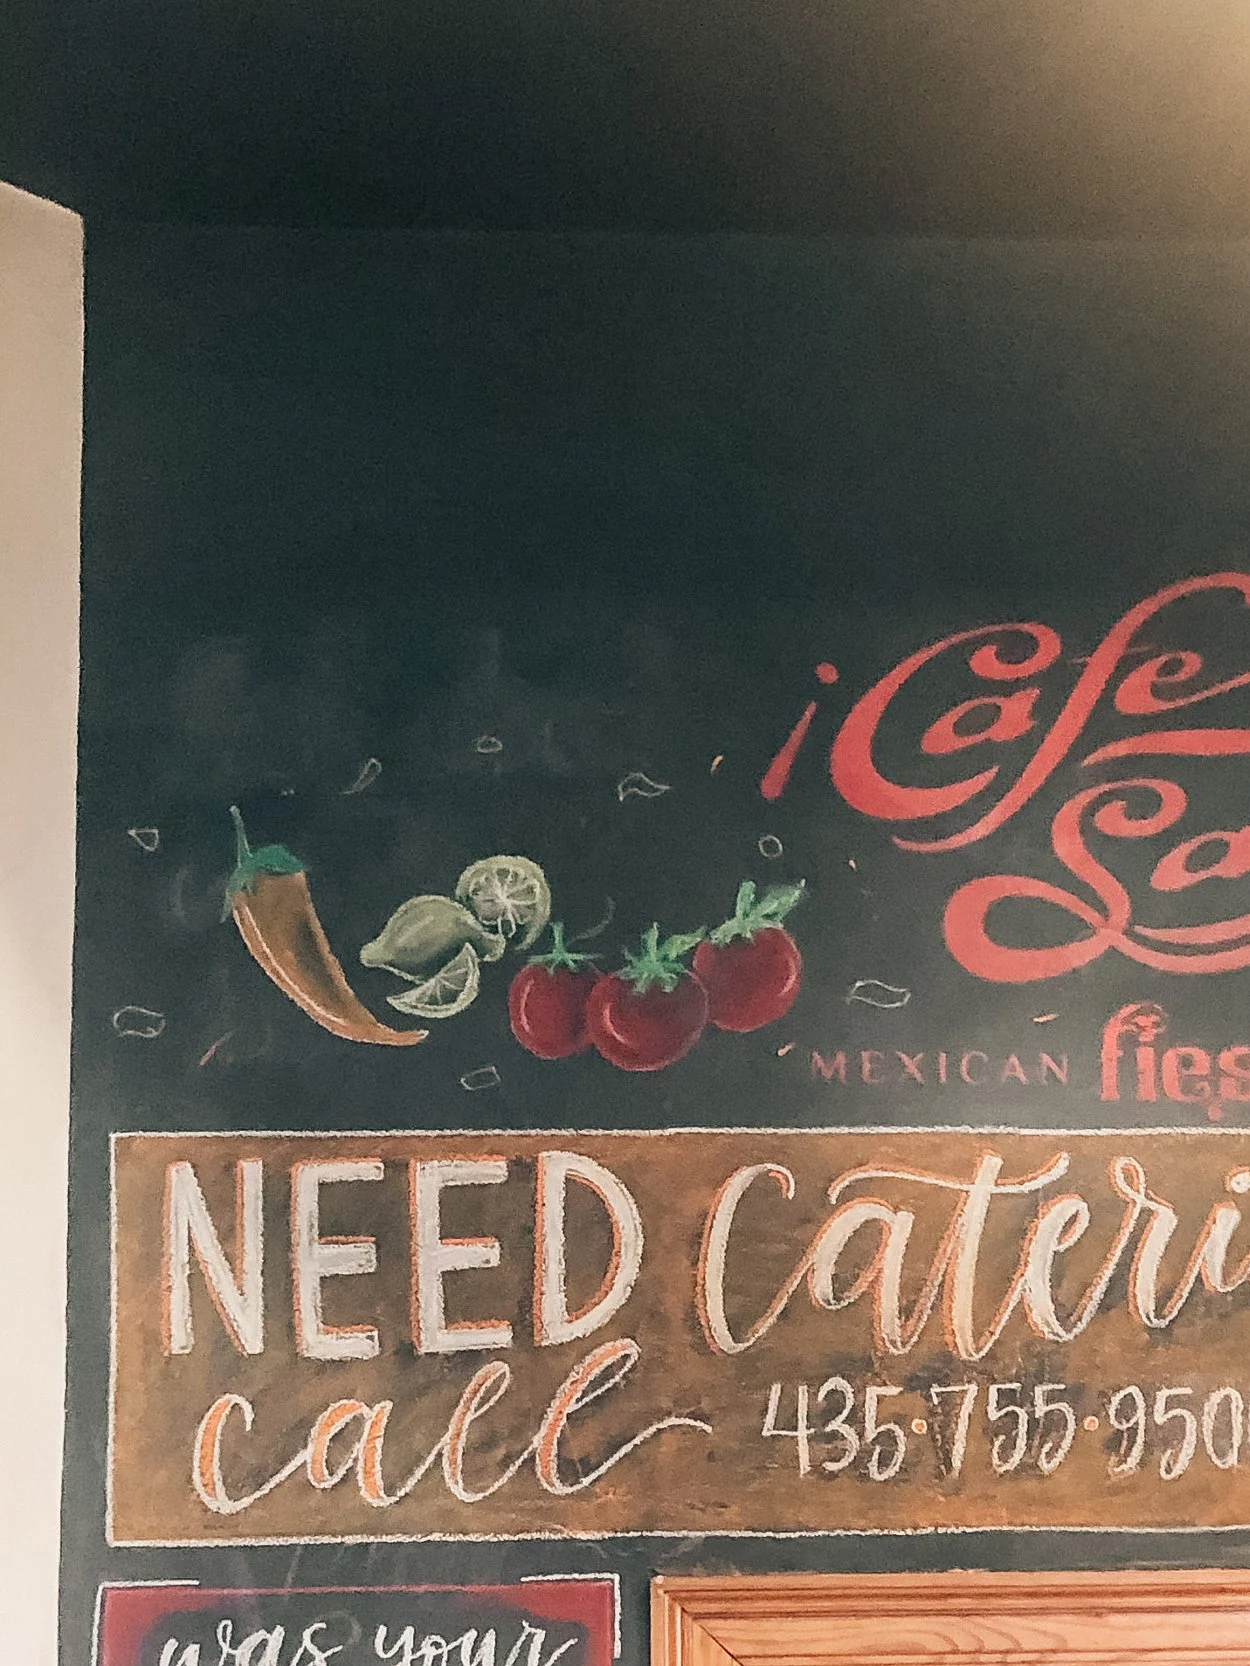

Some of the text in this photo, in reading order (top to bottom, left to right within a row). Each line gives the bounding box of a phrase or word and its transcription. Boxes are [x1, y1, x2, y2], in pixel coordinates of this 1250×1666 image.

[809, 1050, 1070, 1085] MEXICAN
[162, 1151, 644, 1360] NEED
[192, 1338, 713, 1515] call
